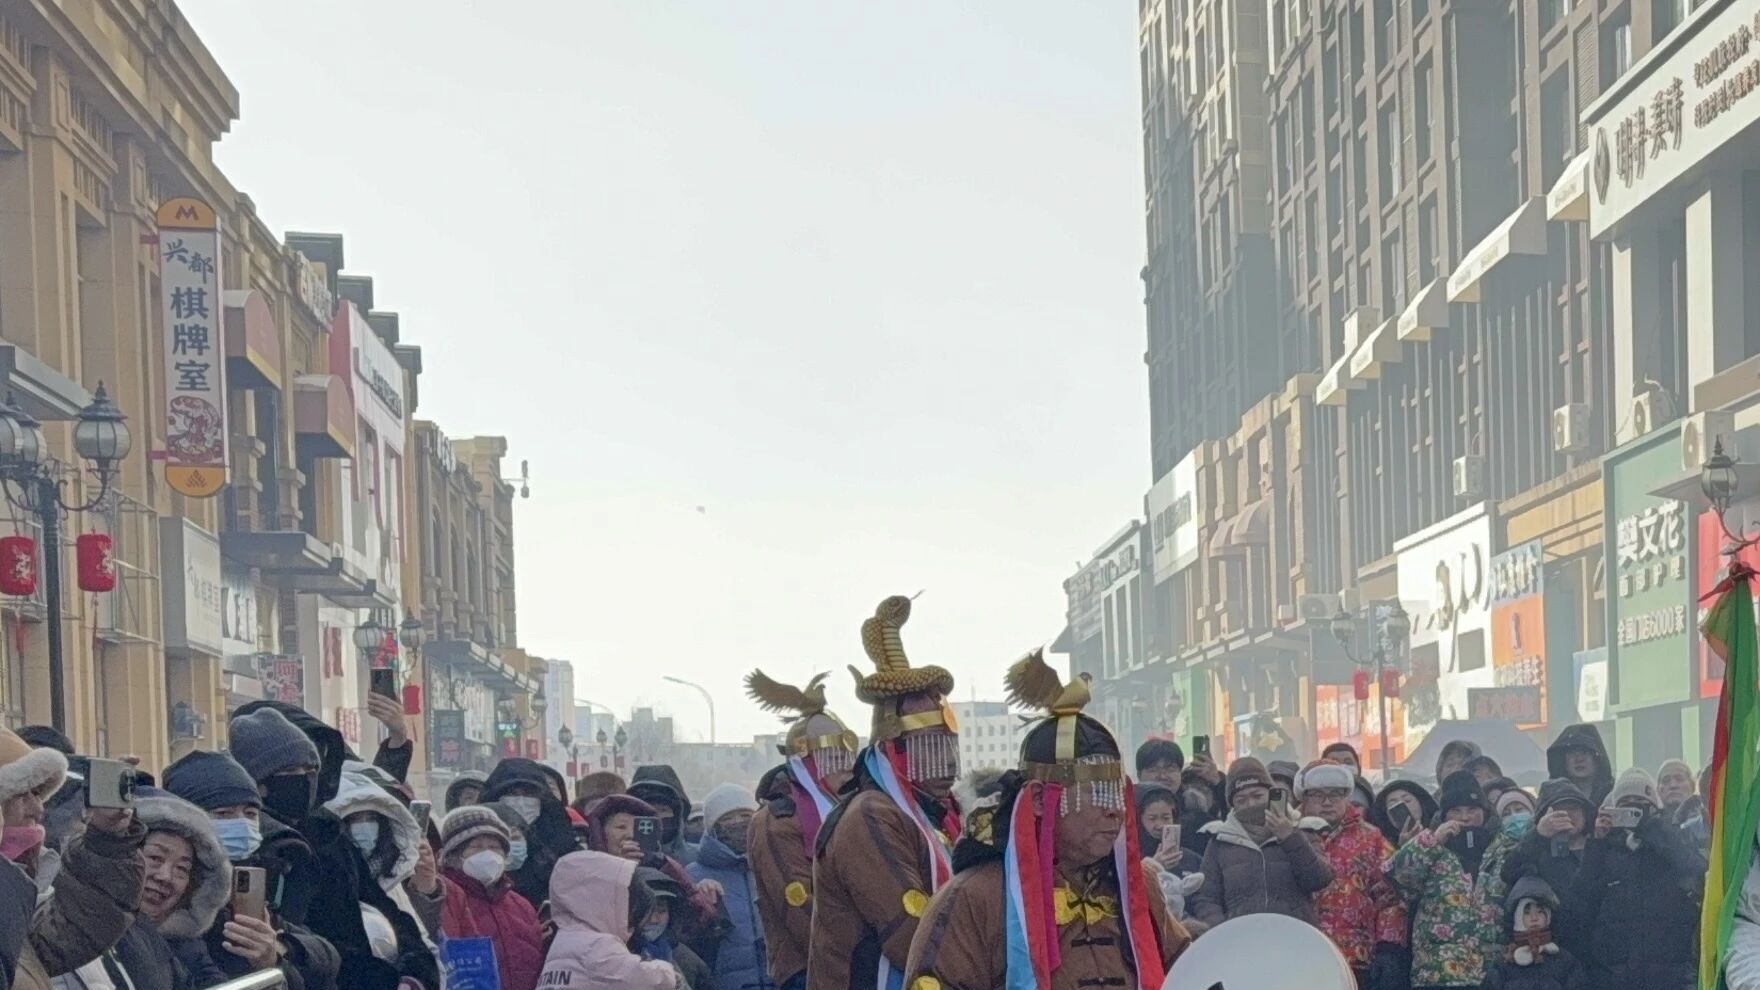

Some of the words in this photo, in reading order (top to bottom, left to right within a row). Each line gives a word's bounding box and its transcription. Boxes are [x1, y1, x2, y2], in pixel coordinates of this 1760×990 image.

[170, 286, 212, 393] 棋牌室
[1617, 498, 1681, 567] 樊文花
